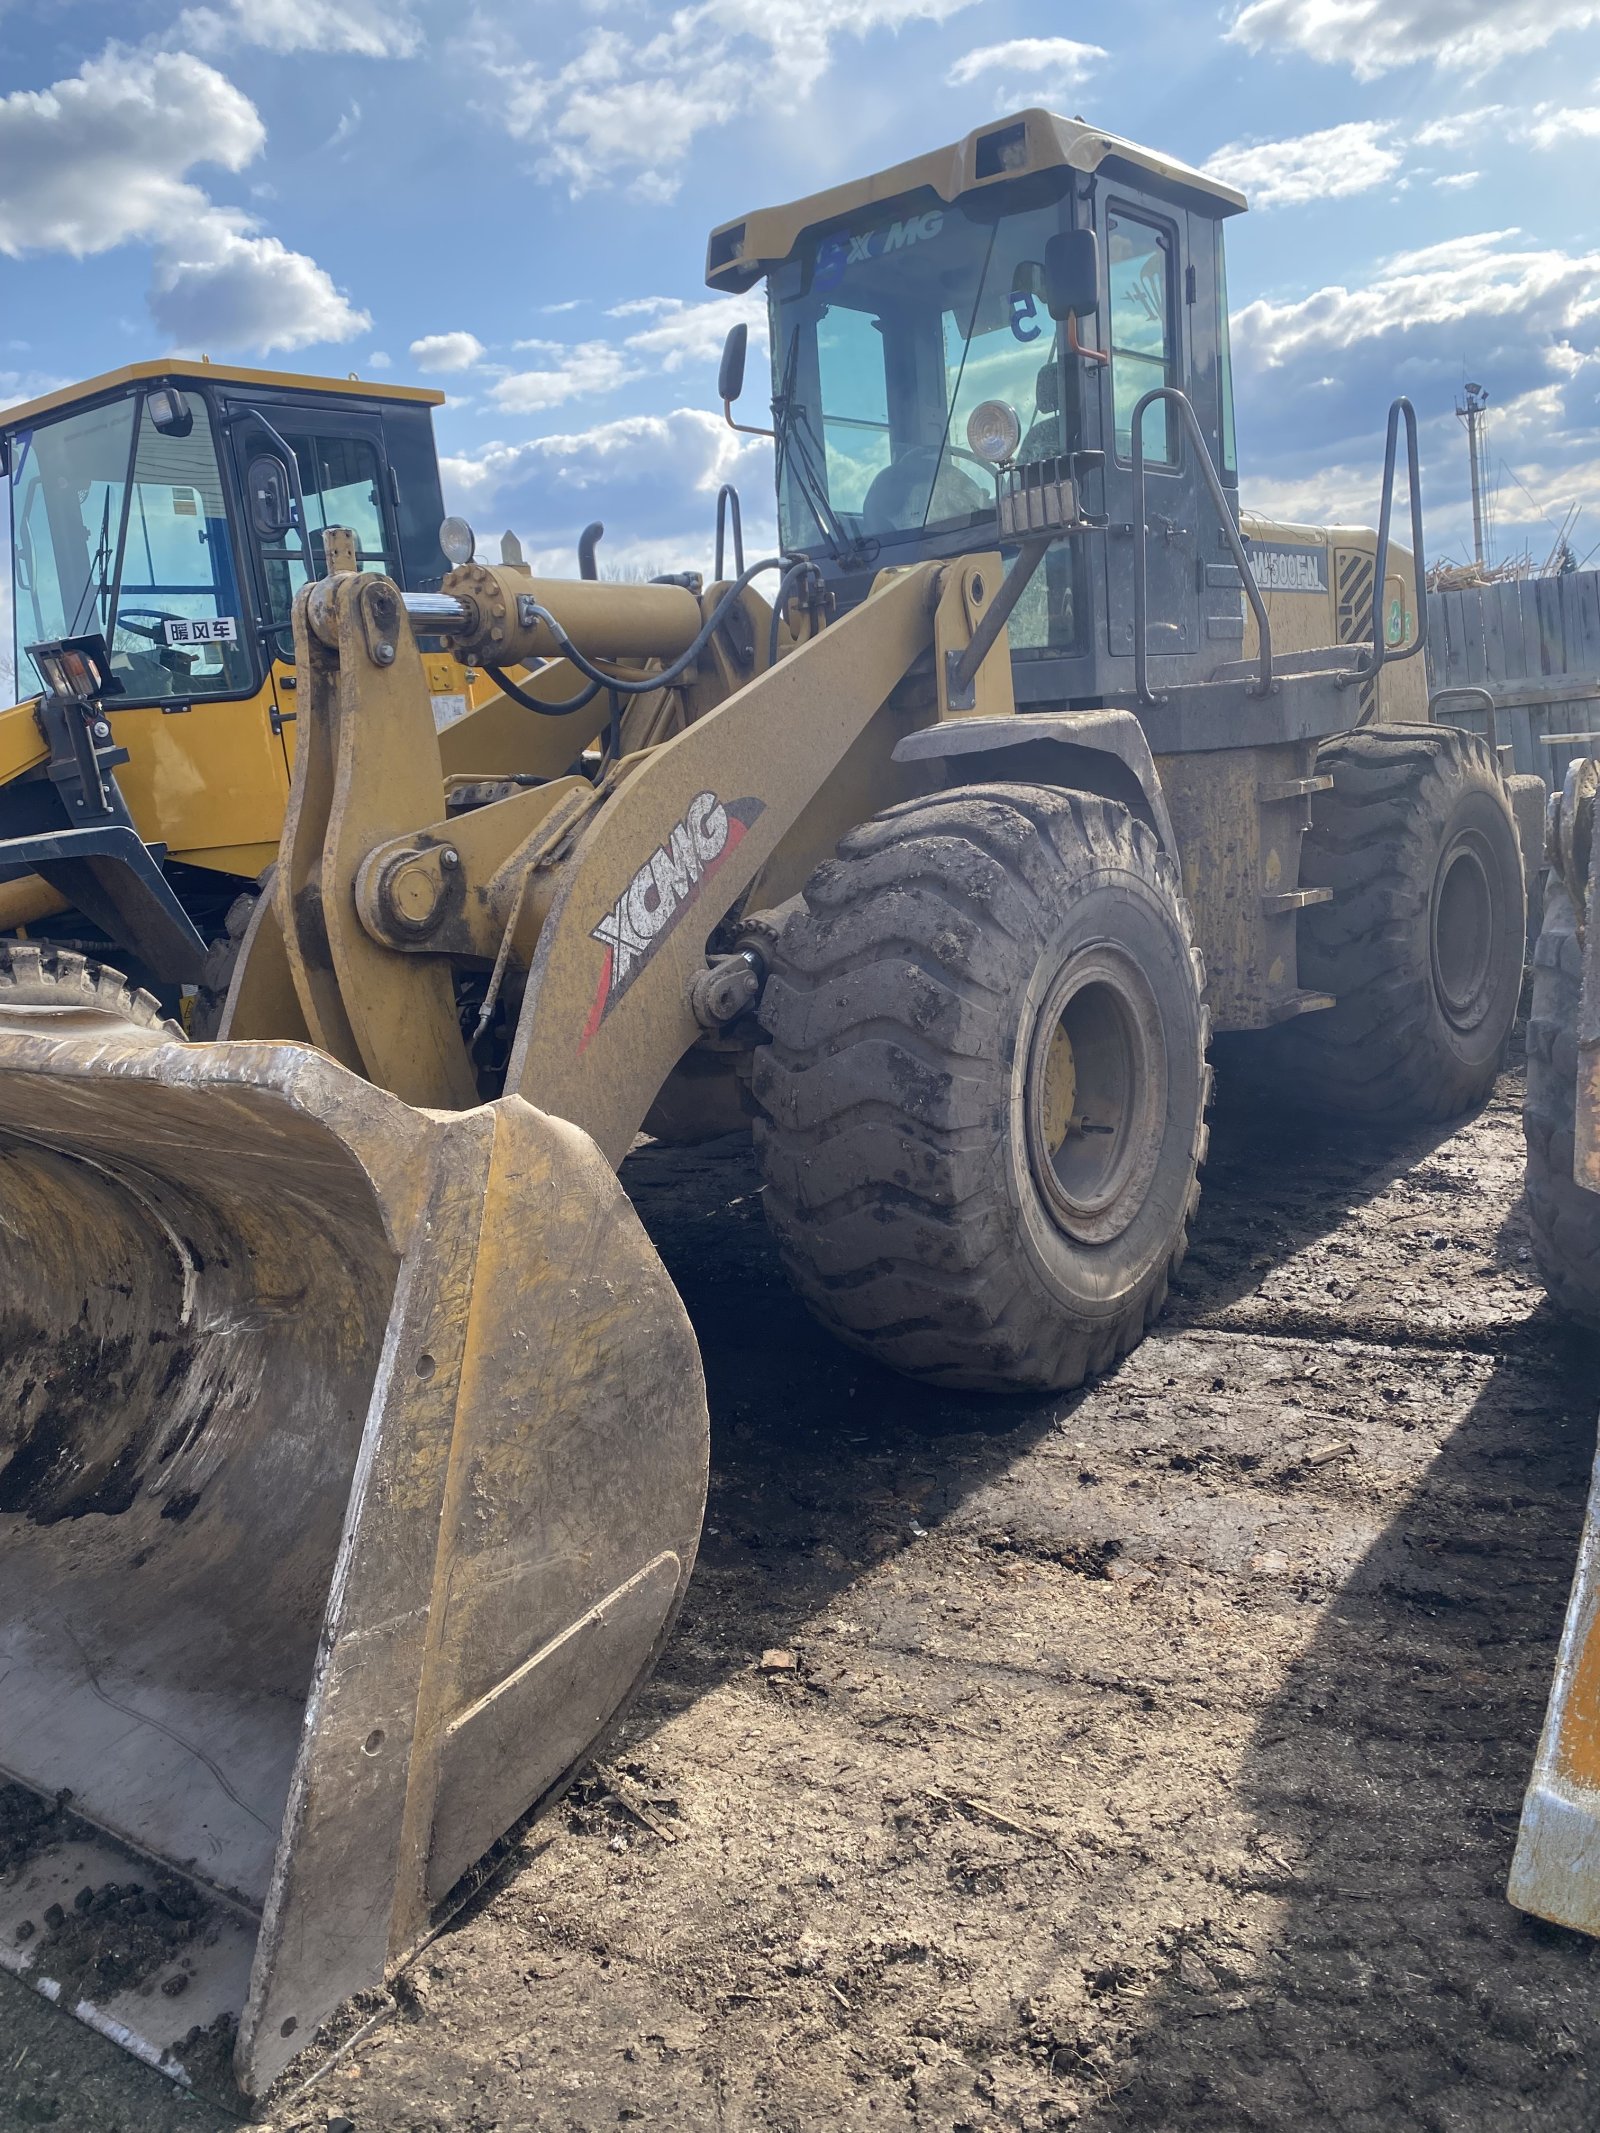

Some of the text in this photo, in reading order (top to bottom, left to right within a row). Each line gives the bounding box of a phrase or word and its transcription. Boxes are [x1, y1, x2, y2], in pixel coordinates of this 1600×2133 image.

[846, 209, 944, 265] XMG
[1244, 550, 1320, 587] W500FN
[170, 620, 231, 641] 暖风车
[591, 790, 731, 991] XCMG
